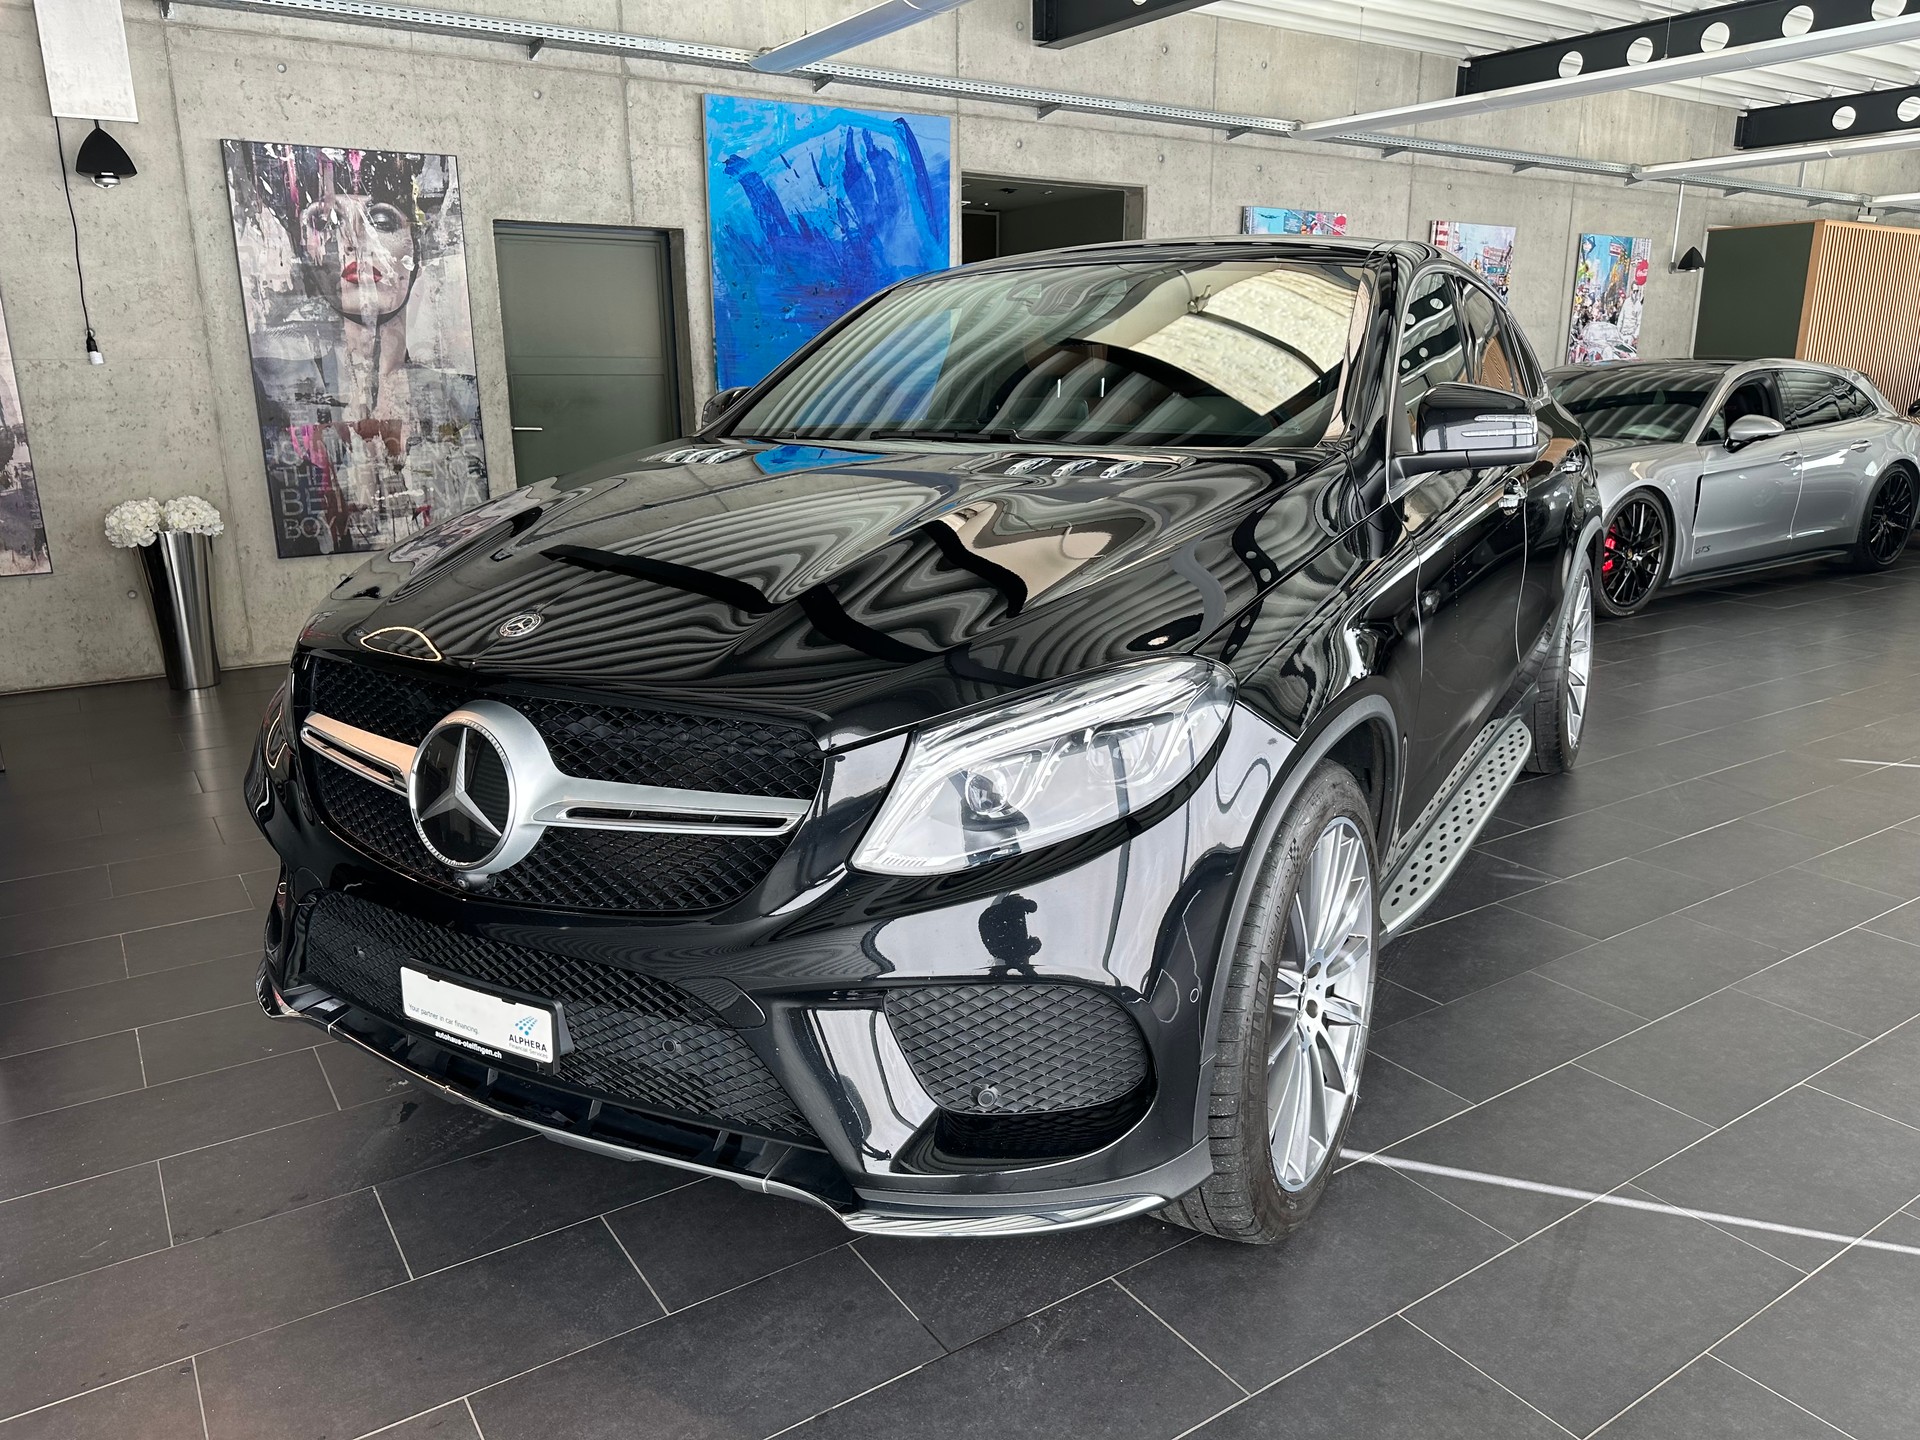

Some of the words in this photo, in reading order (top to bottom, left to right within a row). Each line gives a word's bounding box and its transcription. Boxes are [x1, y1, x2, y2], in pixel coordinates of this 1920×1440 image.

[1694, 544, 1711, 555] GTS
[408, 1003, 420, 1014] Your
[420, 1008, 439, 1020] partner
[445, 1017, 454, 1025] car
[508, 1042, 529, 1053] Financial
[529, 1048, 549, 1060] Services
[509, 1034, 548, 1052] ALPHERA
